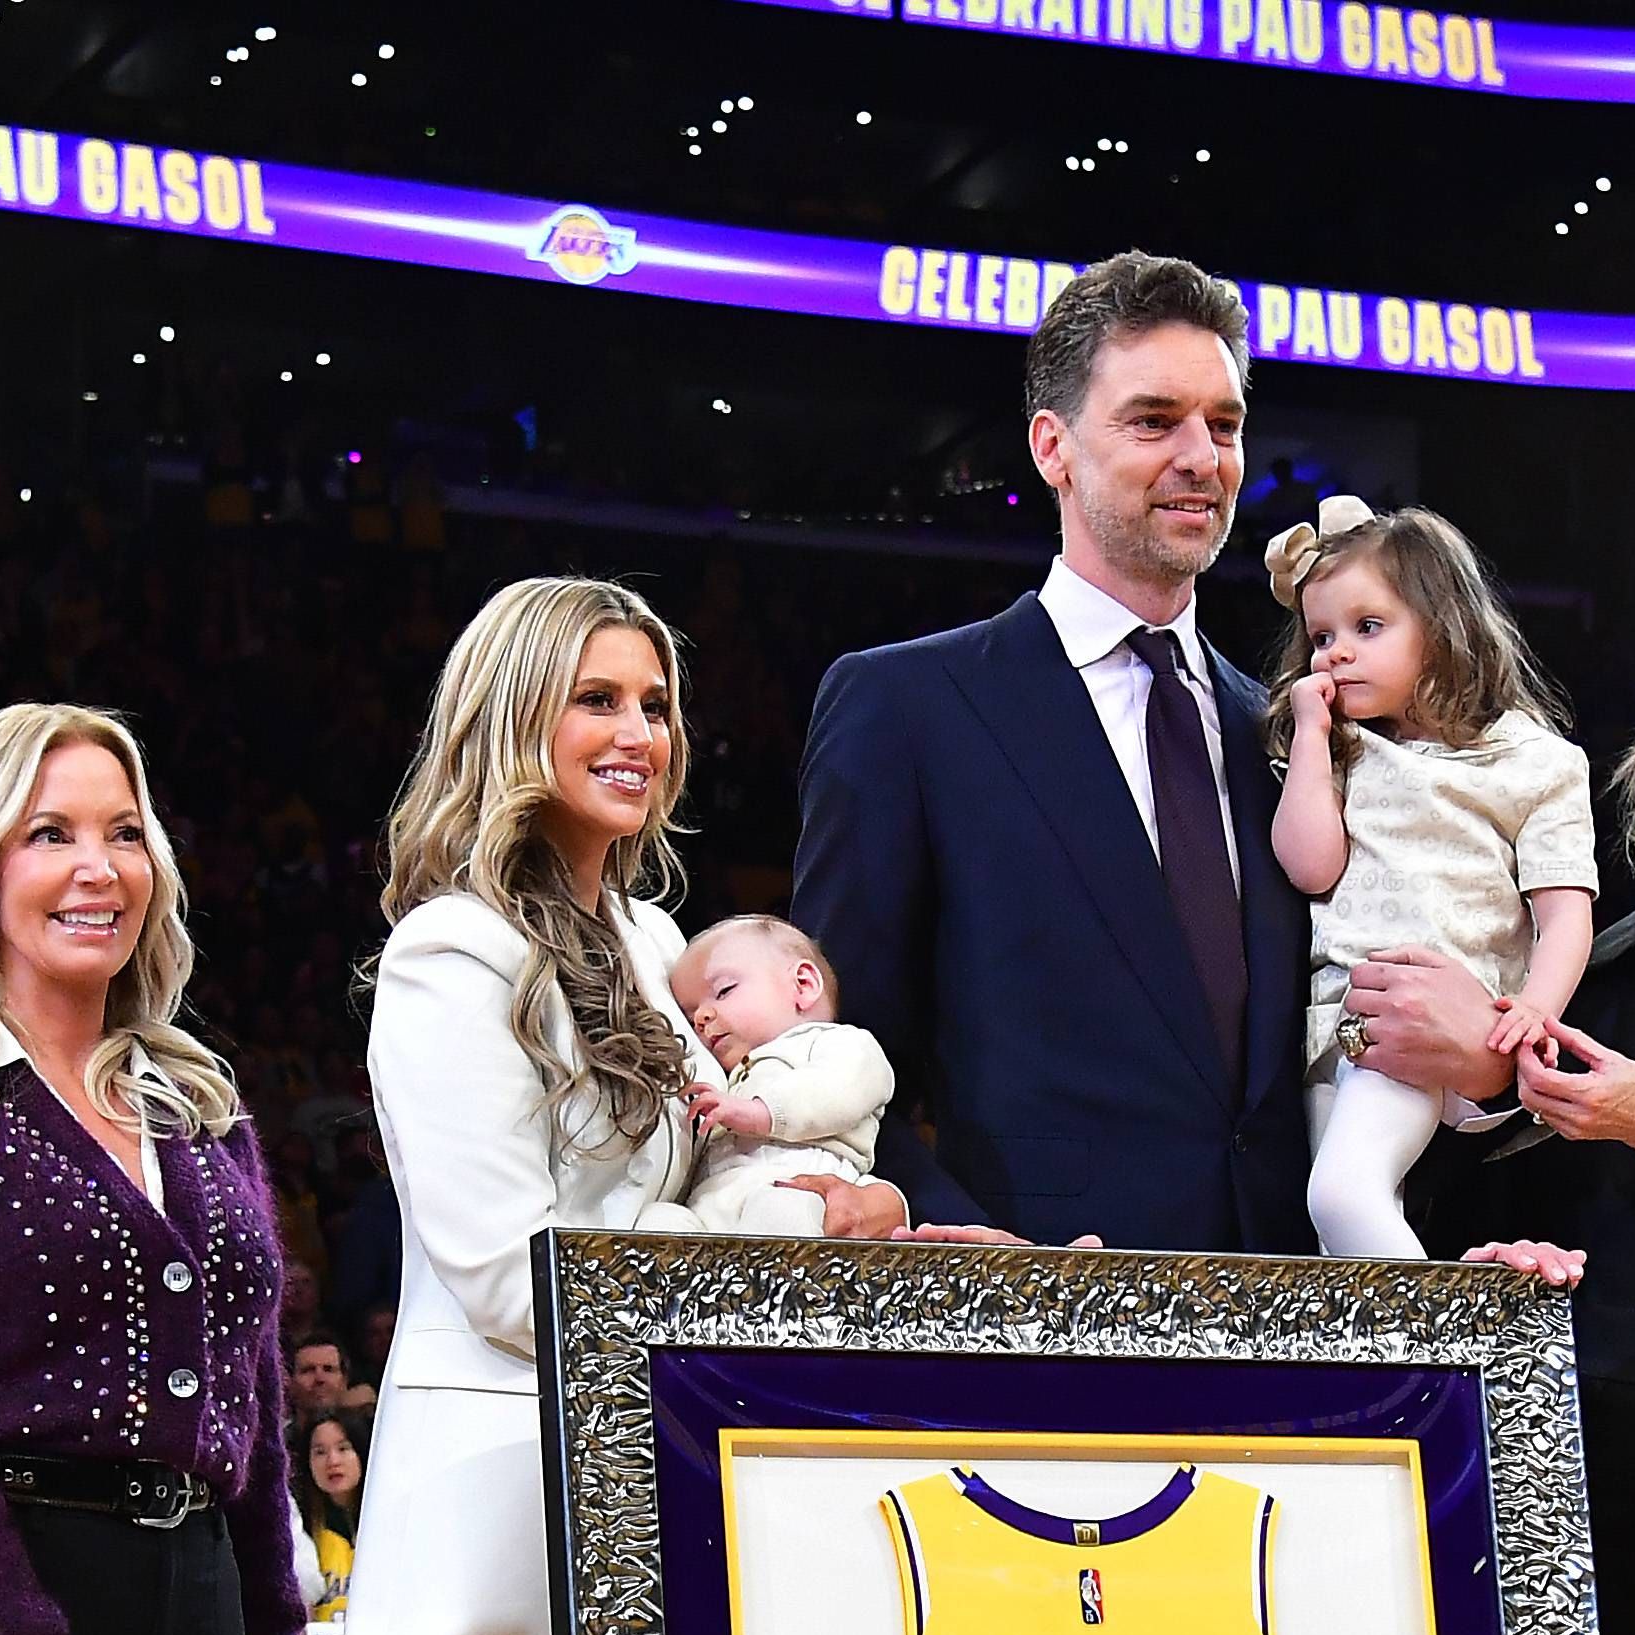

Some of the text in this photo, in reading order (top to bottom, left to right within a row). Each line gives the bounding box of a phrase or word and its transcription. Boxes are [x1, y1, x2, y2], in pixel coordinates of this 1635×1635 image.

[1217, 0, 1324, 65] PAU
[1338, 1, 1506, 87] GASOL
[76, 137, 277, 235] GASOL
[1257, 282, 1363, 361] PAU
[1376, 295, 1545, 379] GASOL
